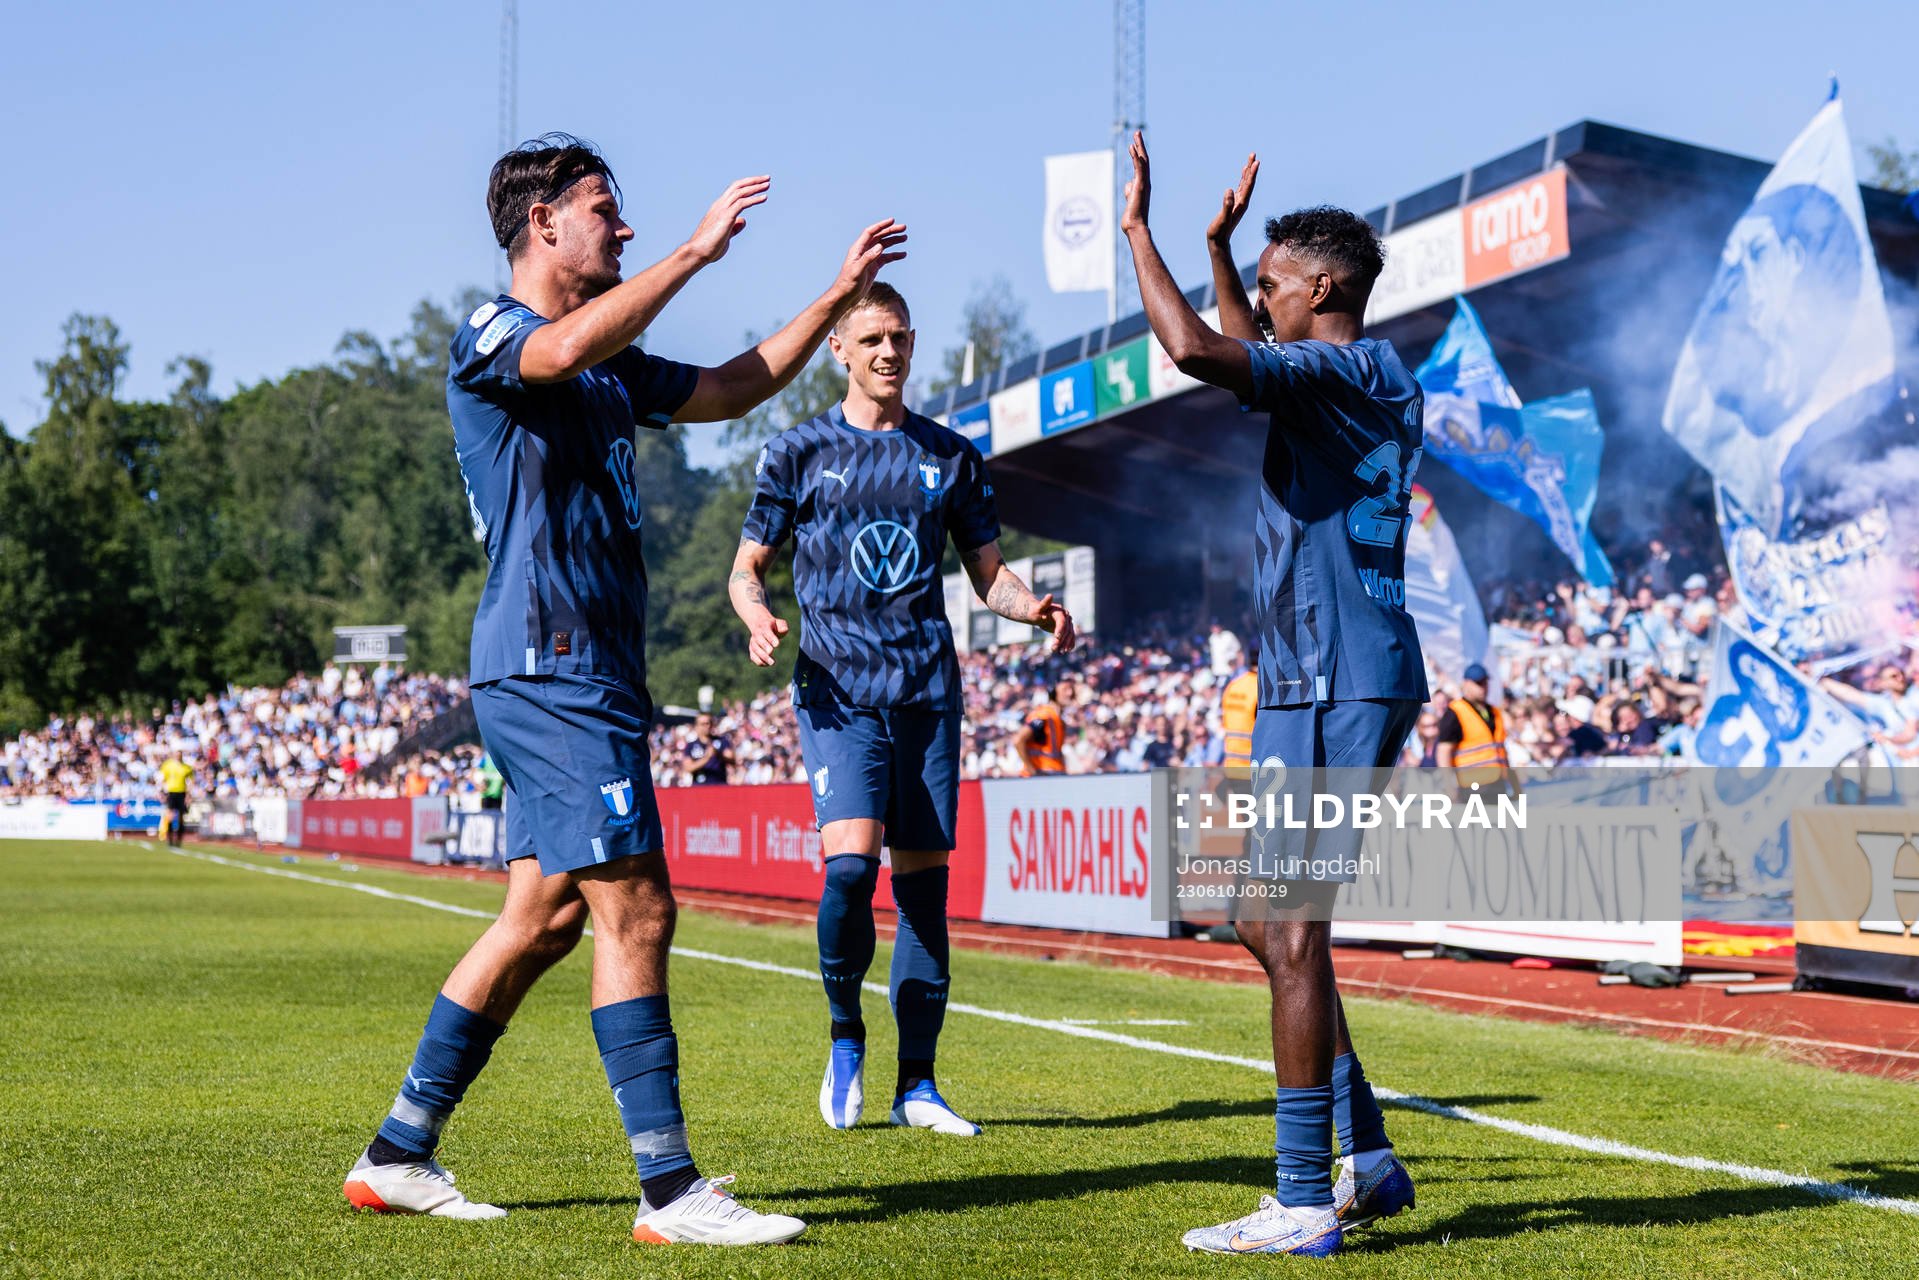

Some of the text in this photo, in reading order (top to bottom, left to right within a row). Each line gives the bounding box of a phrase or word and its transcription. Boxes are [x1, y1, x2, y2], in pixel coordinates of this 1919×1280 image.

[1472, 183, 1549, 256] ramo
[1009, 806, 1148, 899] SANDAHLS
[1446, 821, 1658, 925] NOMINIT
